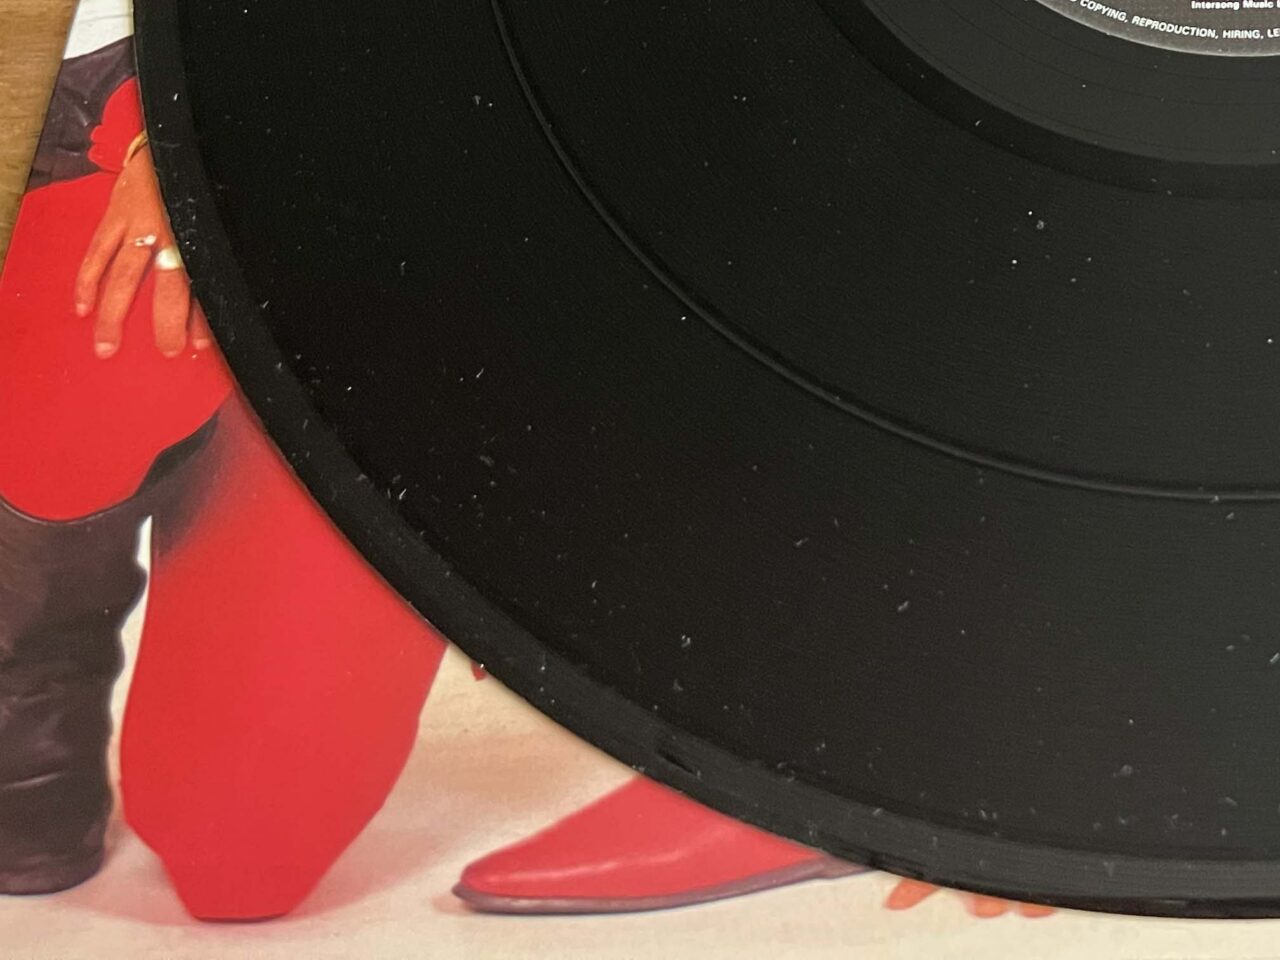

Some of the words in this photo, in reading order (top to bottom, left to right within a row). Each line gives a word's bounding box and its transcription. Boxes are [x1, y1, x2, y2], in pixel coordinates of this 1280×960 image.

[1191, 0, 1240, 10] Intersong
[1242, 0, 1274, 9] Music
[1132, 16, 1219, 39] REPRODUCTION,
[1223, 30, 1264, 39] HIRING,
